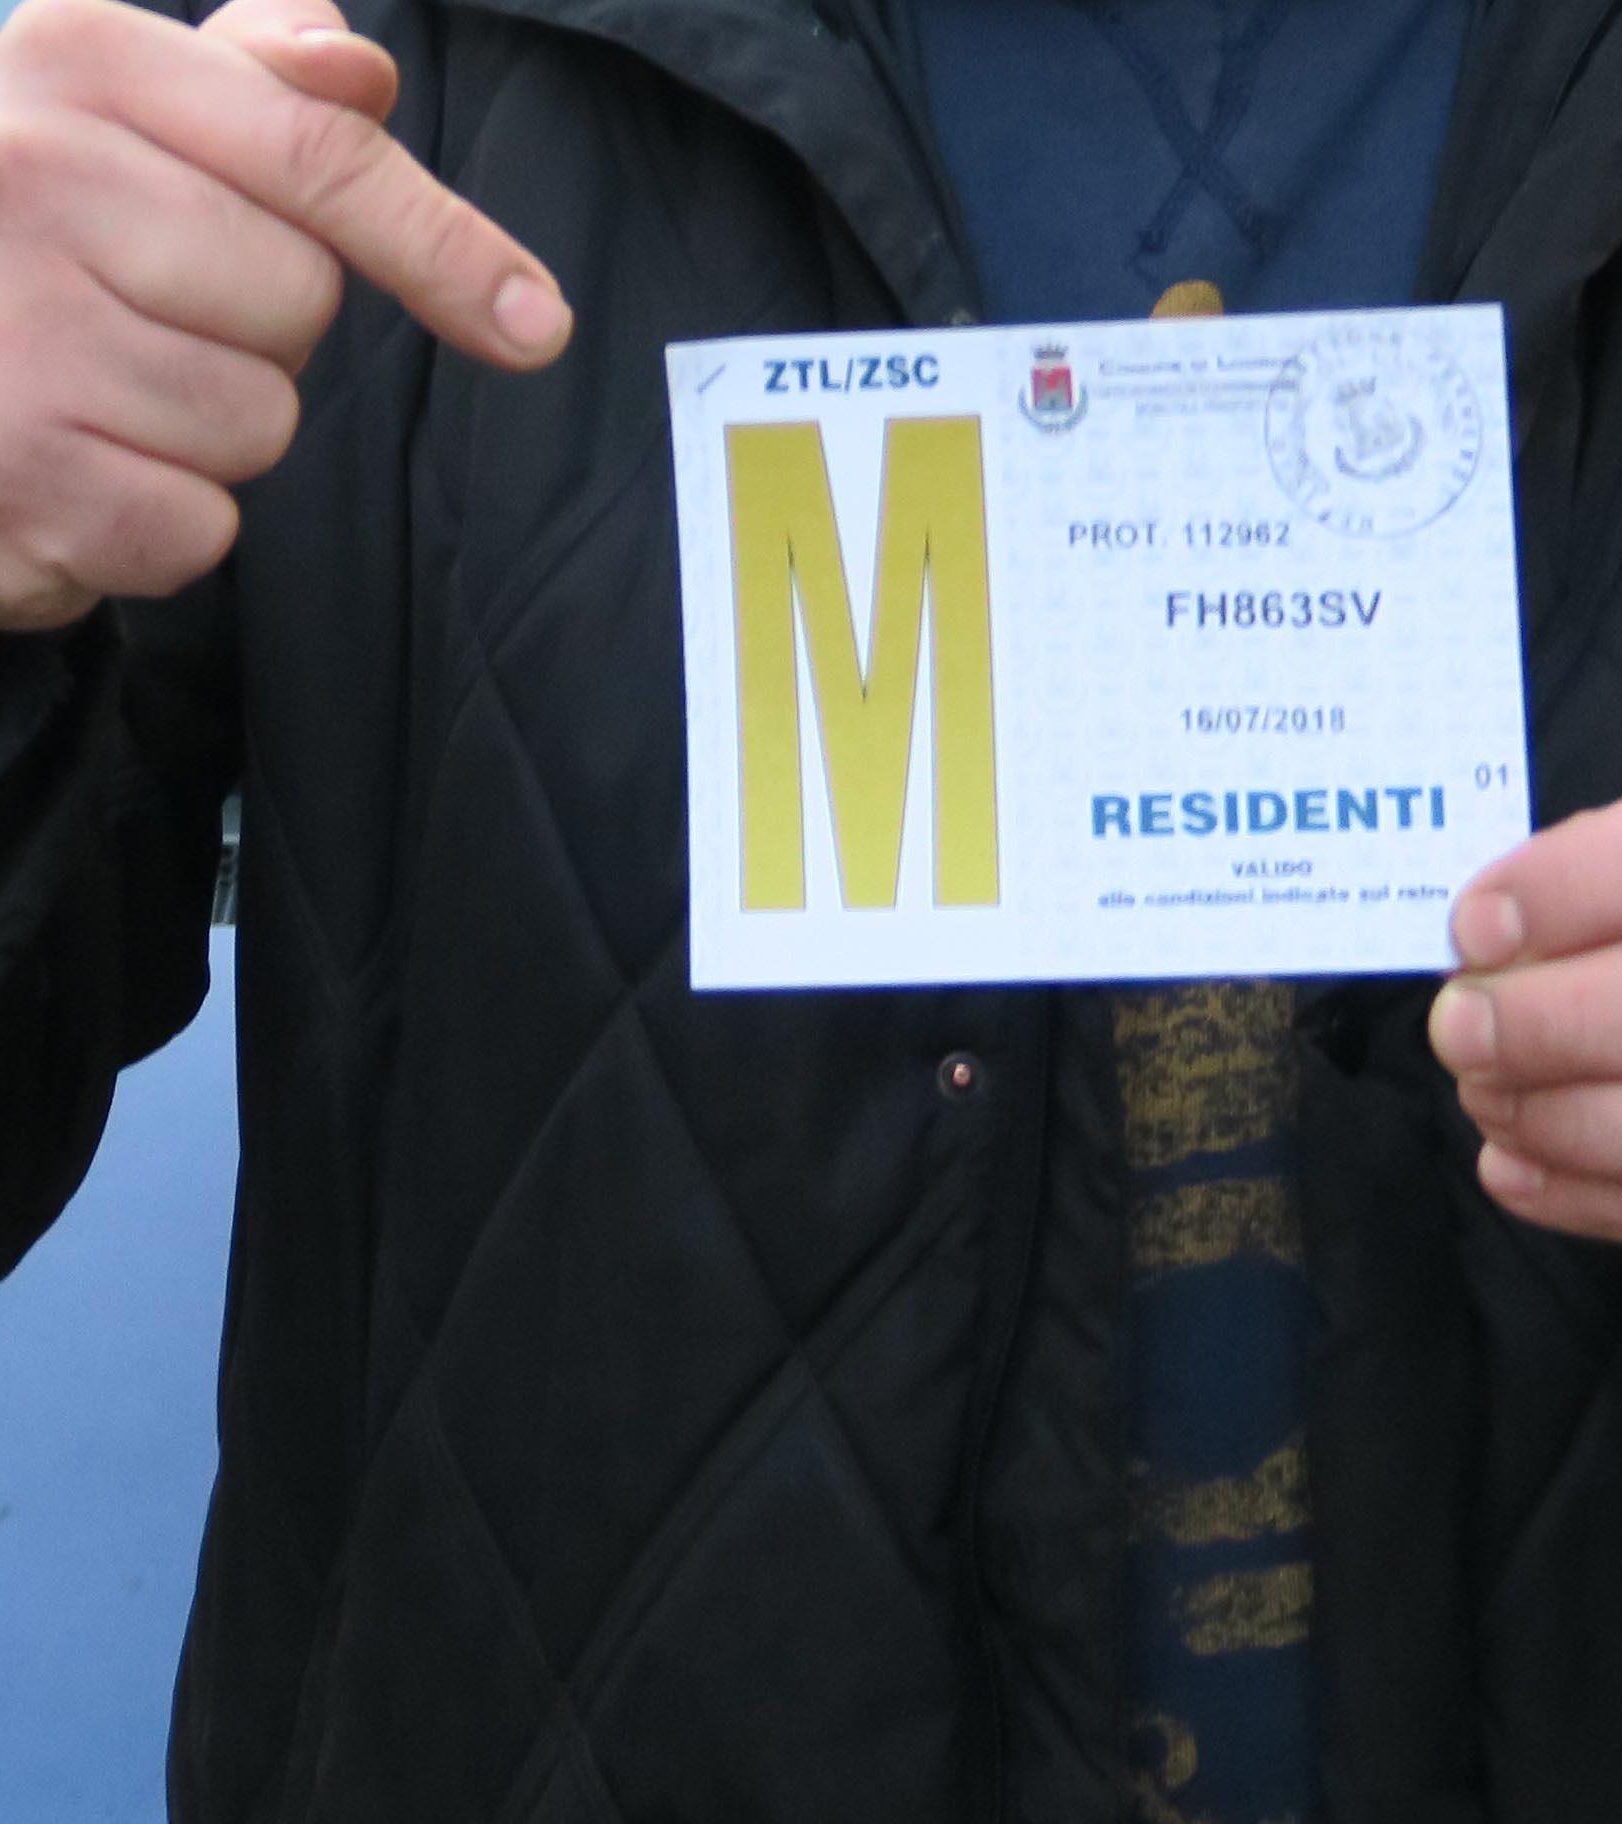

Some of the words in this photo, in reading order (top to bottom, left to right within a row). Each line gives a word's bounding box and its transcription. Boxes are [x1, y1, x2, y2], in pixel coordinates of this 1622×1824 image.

[763, 354, 940, 394] ZTL/ZSC
[1069, 518, 1167, 549] PROT.
[1184, 521, 1291, 549] 112962
[1165, 588, 1383, 629] FH863SV
[724, 414, 1000, 911] M
[1180, 704, 1346, 736] 16/07/2018
[1474, 762, 1509, 791] 01
[1091, 785, 1446, 839] RESIDENTI
[1230, 859, 1315, 879] VALIDO
